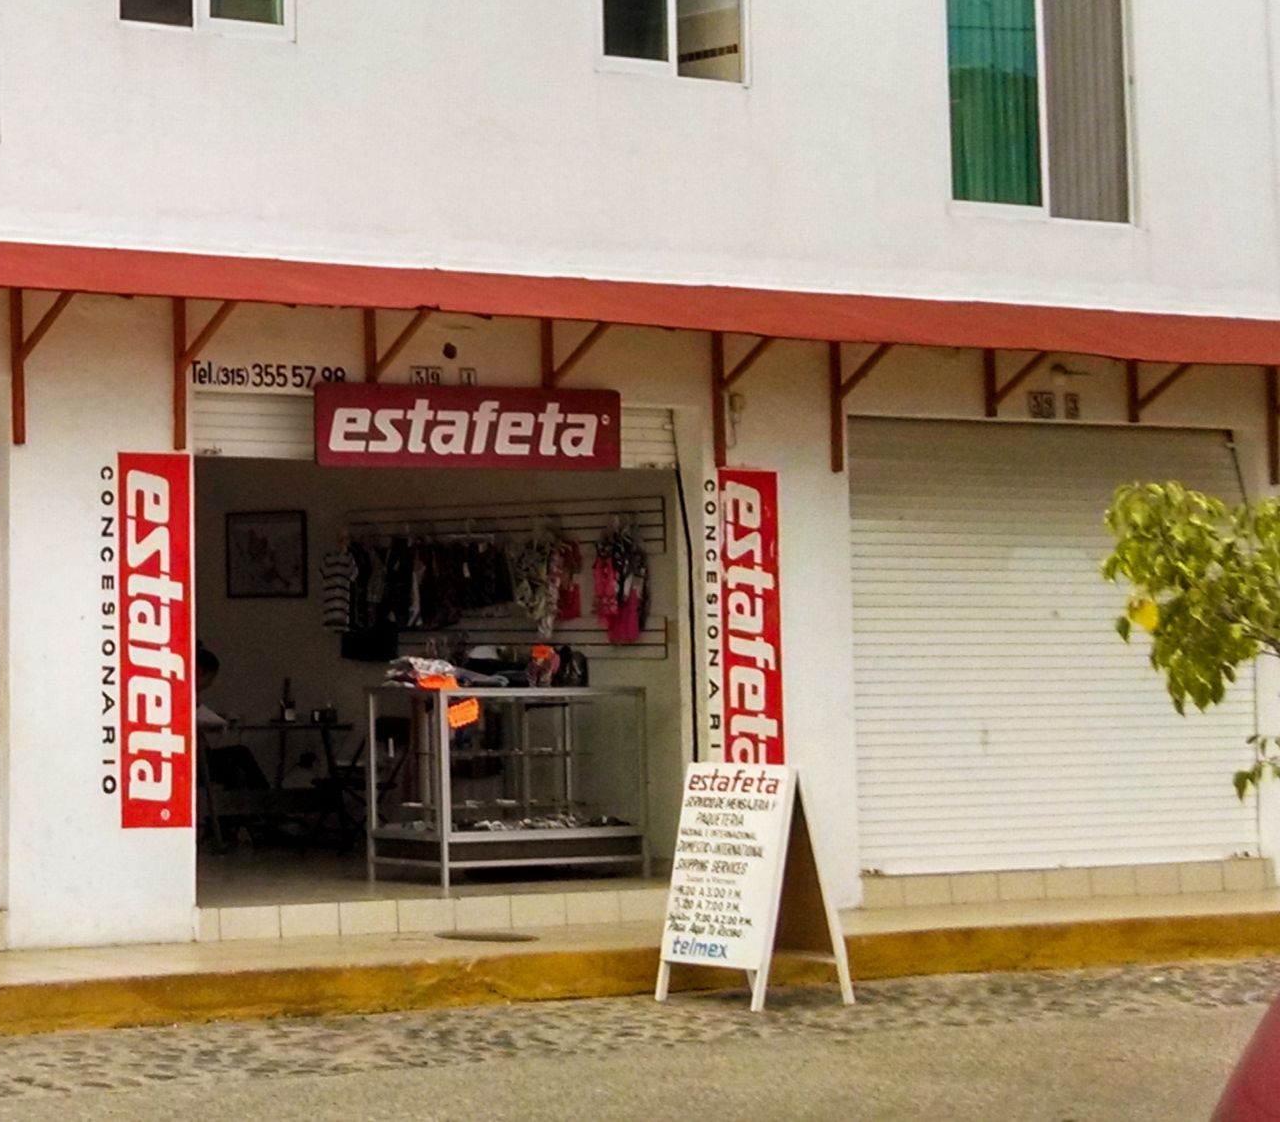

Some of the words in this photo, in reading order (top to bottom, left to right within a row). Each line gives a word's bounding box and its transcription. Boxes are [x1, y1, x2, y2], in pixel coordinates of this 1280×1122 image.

[252, 363, 288, 387] 355
[291, 365, 316, 389] 57
[328, 398, 598, 458] estafeta
[100, 465, 117, 795] CONCESIONARIO
[127, 469, 185, 802] estafeta
[704, 479, 721, 749] CONCESIONARI
[688, 769, 780, 794] estafeta
[672, 936, 728, 958] telmex
